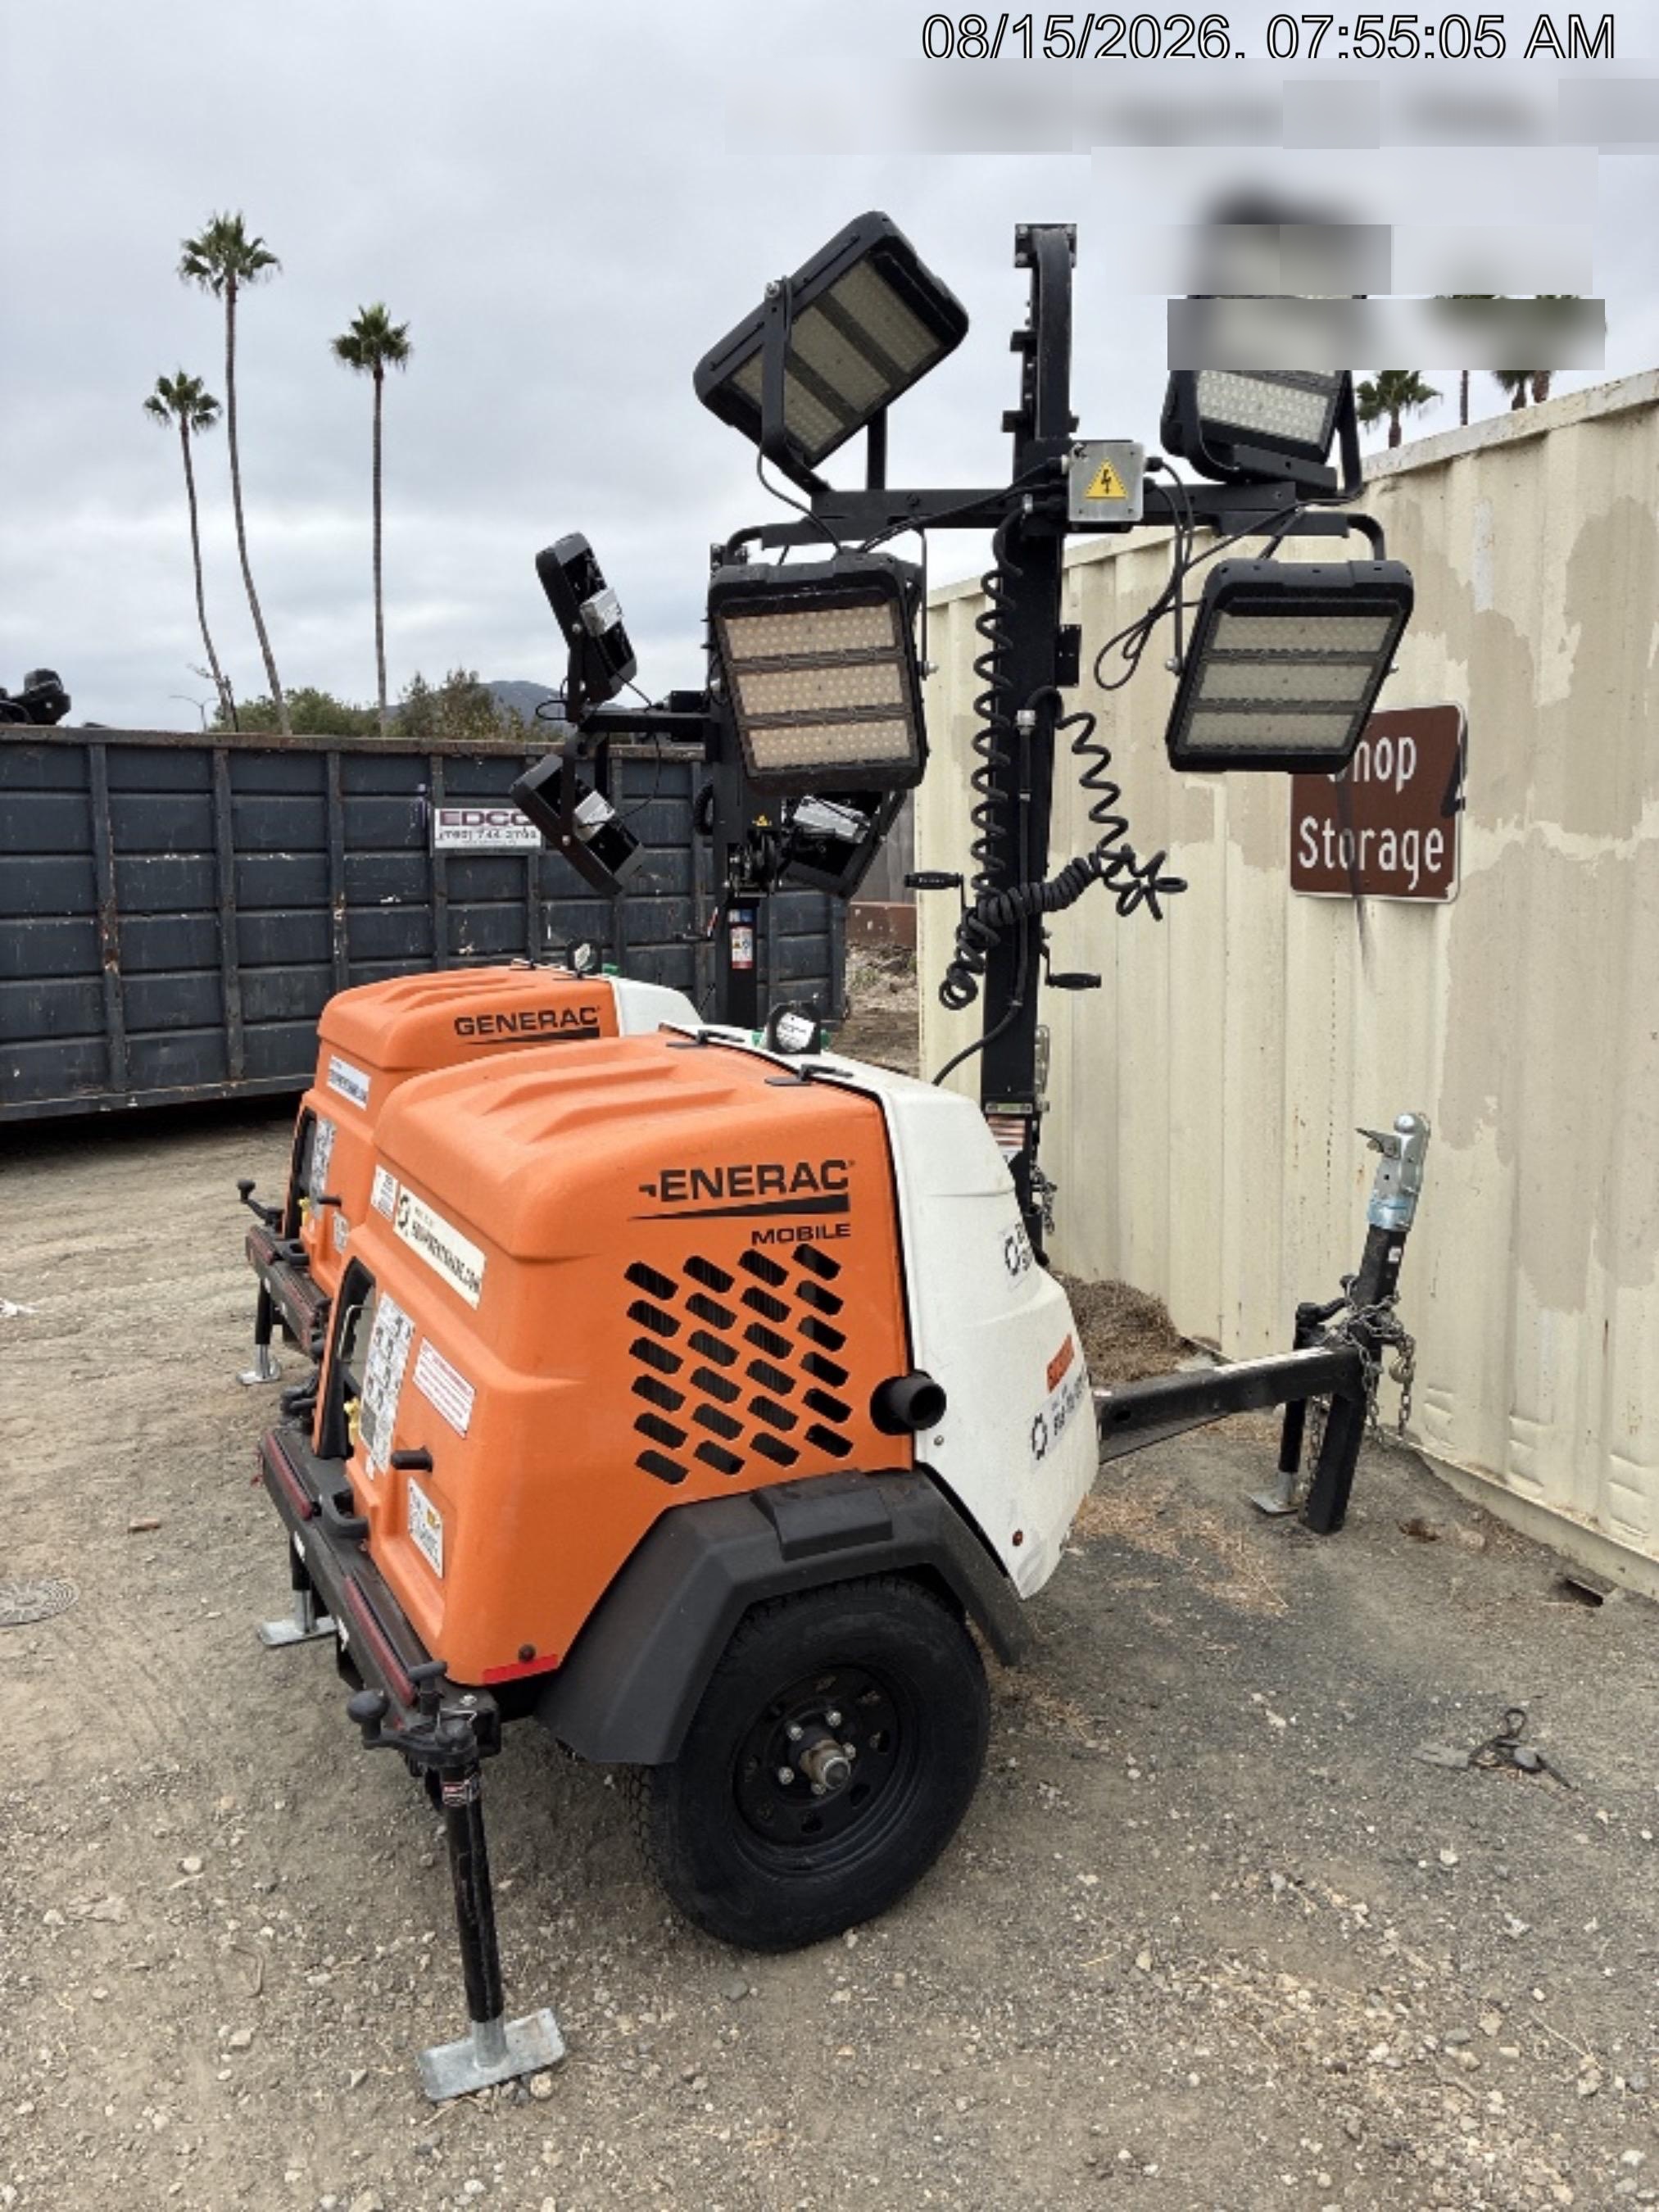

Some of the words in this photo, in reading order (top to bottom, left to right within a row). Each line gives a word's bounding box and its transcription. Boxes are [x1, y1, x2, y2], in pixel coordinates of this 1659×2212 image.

[1328, 736, 1417, 794] hop
[1298, 816, 1444, 891] Storage
[454, 1007, 598, 1036] GENERAC
[638, 1159, 849, 1202] ENERAC
[750, 1224, 851, 1245] MOBILE
